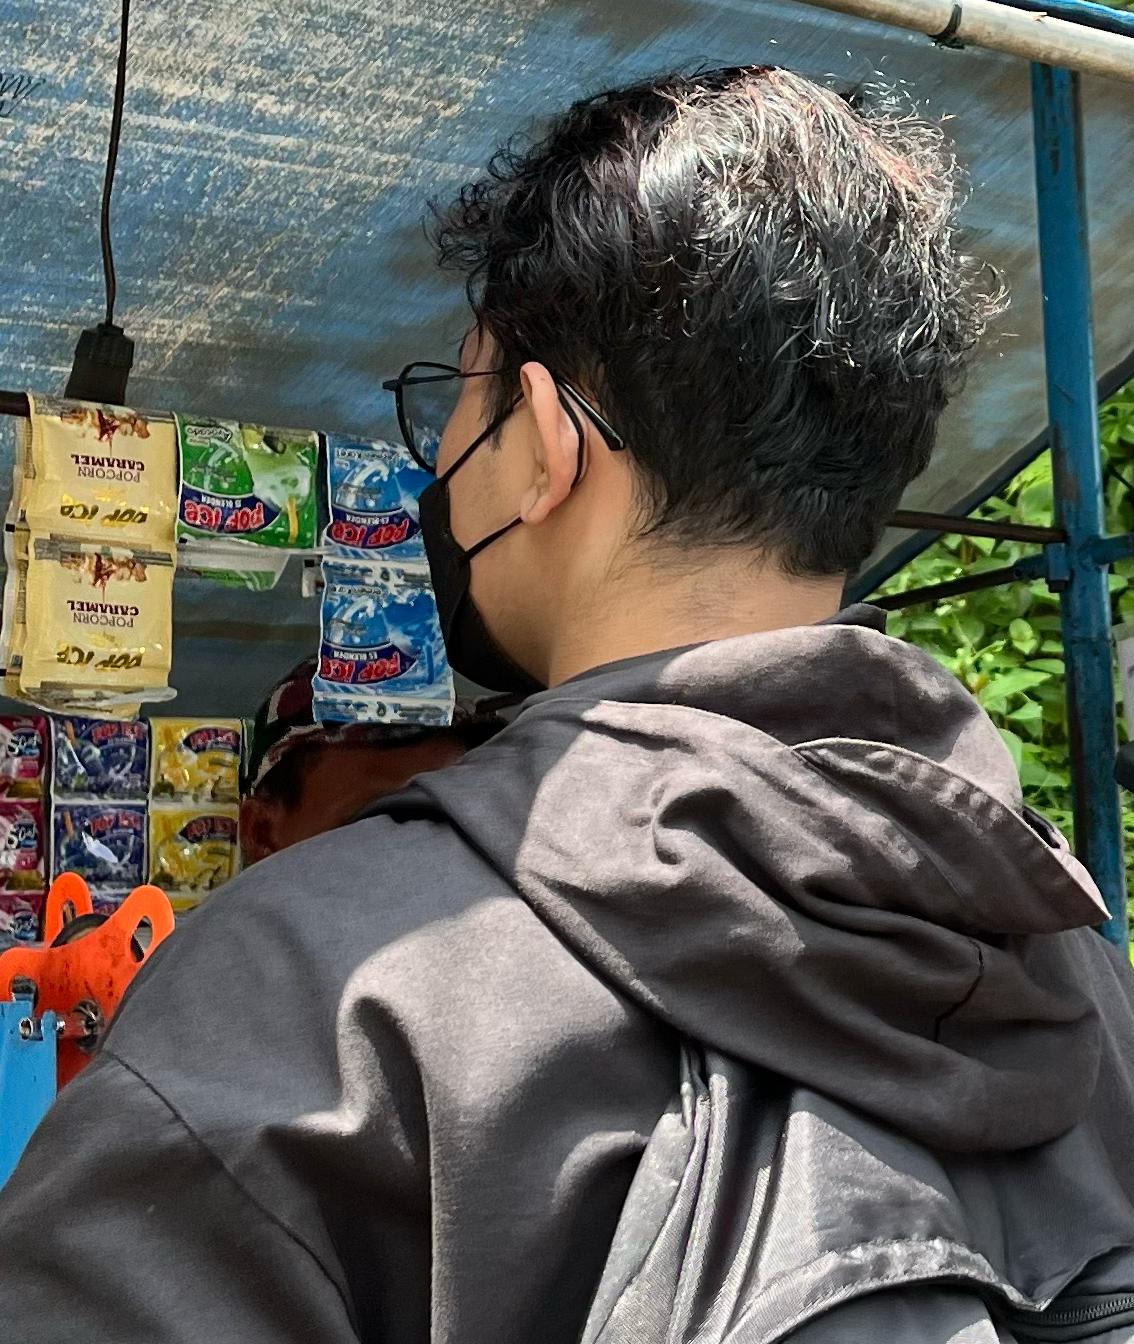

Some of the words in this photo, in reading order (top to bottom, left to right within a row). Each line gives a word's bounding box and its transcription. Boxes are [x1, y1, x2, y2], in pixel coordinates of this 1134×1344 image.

[70, 453, 146, 472] CARAMEL
[77, 465, 141, 484] POPCORN
[224, 501, 266, 532] POP
[366, 517, 411, 547] POP
[66, 599, 140, 616] CARAMEL
[72, 611, 134, 628] POPCORN
[357, 651, 401, 683] POP
